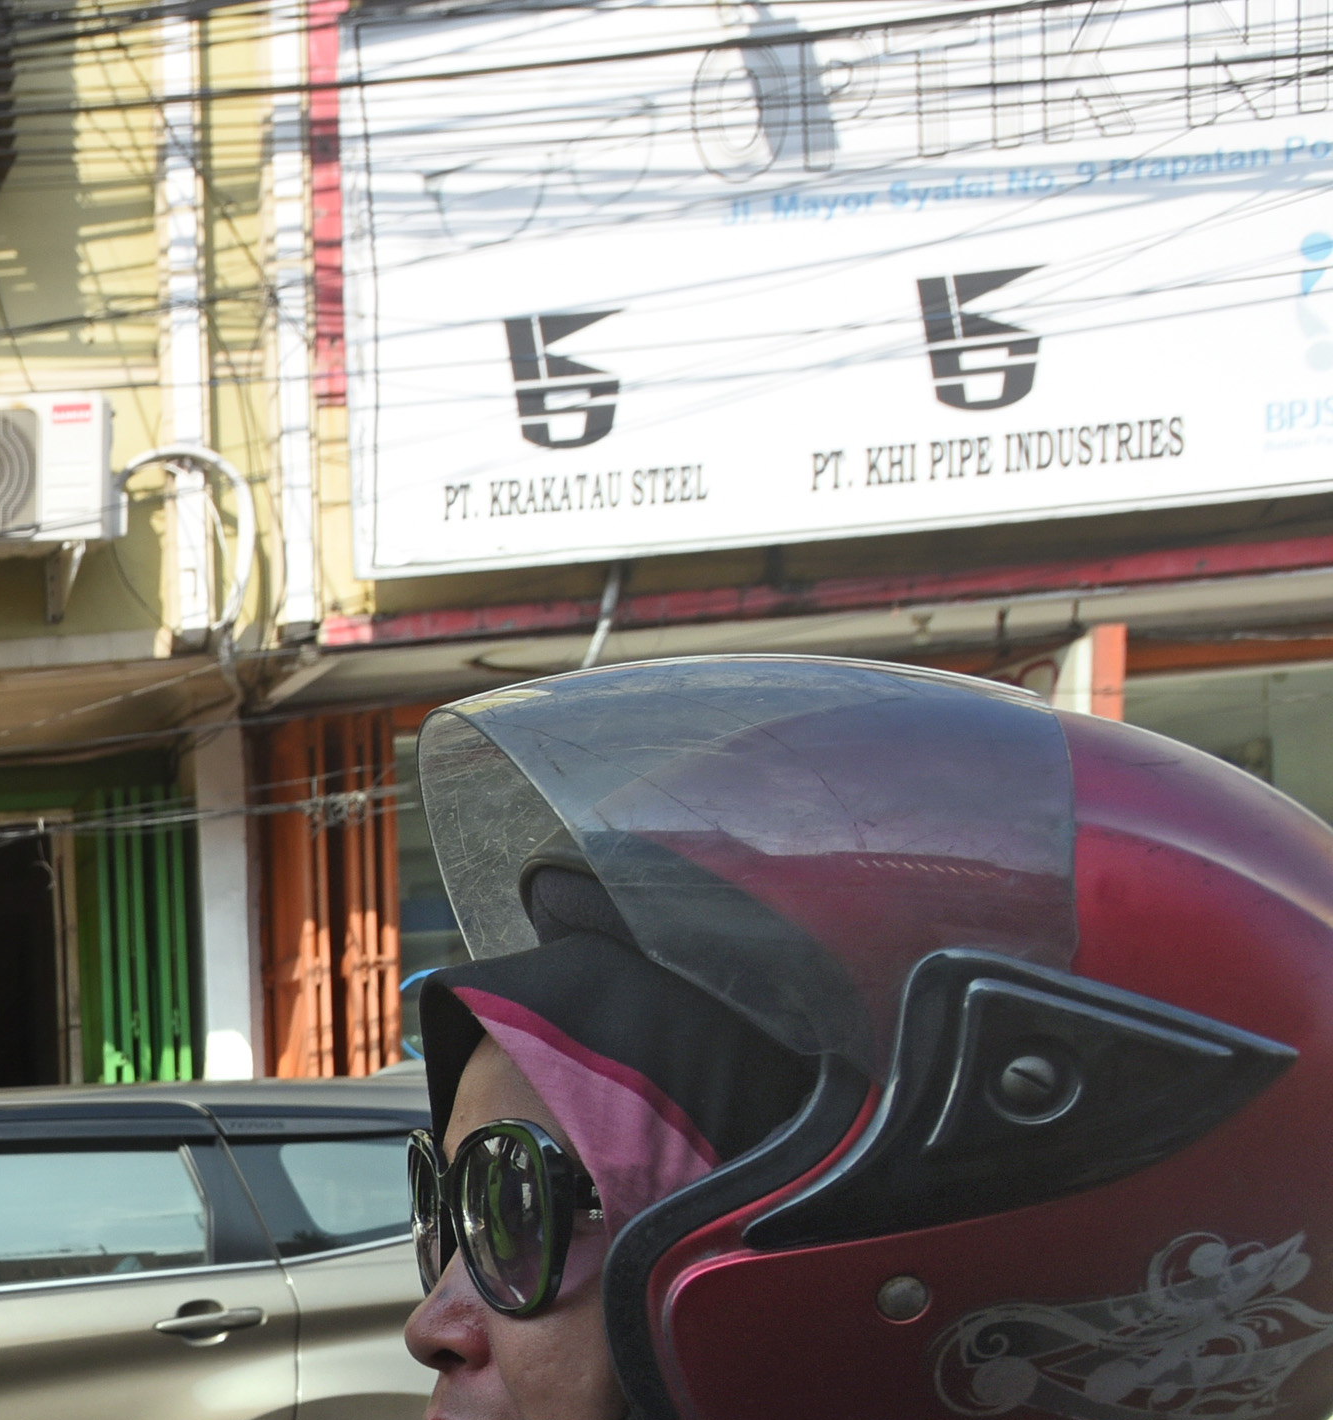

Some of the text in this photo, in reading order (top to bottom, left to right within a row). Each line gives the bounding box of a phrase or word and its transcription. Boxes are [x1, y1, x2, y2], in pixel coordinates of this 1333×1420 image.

[773, 190, 875, 224] Mayor
[1075, 160, 1097, 189] 9
[1284, 134, 1333, 163] Po
[865, 443, 918, 487] KHI
[929, 434, 993, 481] PIPE
[1004, 416, 1186, 474] INDUSTRIES
[489, 470, 623, 518] KRAKATAU
[631, 464, 710, 506] STEEL
